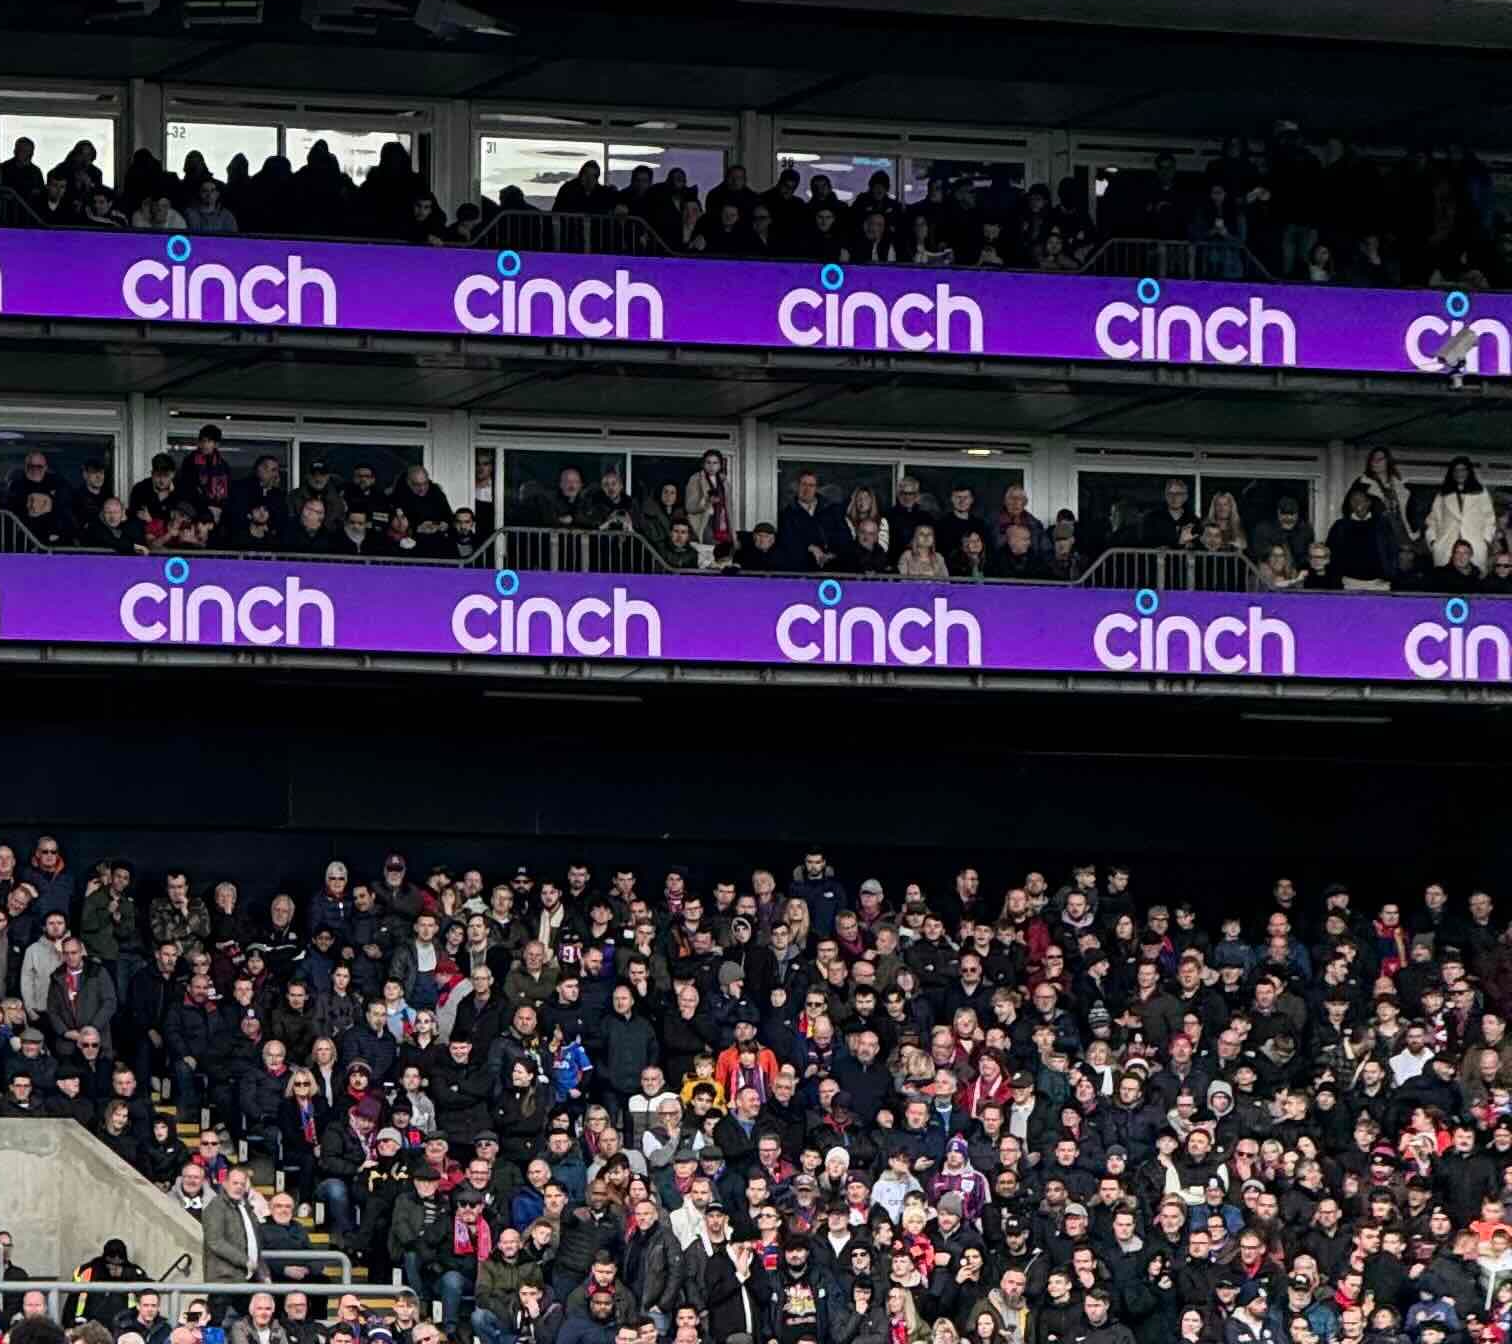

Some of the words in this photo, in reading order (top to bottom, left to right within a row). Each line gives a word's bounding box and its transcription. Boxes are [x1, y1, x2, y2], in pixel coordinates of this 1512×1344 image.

[123, 236, 336, 325] cinch
[455, 251, 662, 338] cinch
[779, 264, 982, 352] cinch
[1096, 278, 1295, 365] cinch
[121, 558, 334, 646] cinch
[452, 570, 660, 656] cinch
[777, 580, 981, 665] cinch
[1094, 589, 1294, 674] cinch
